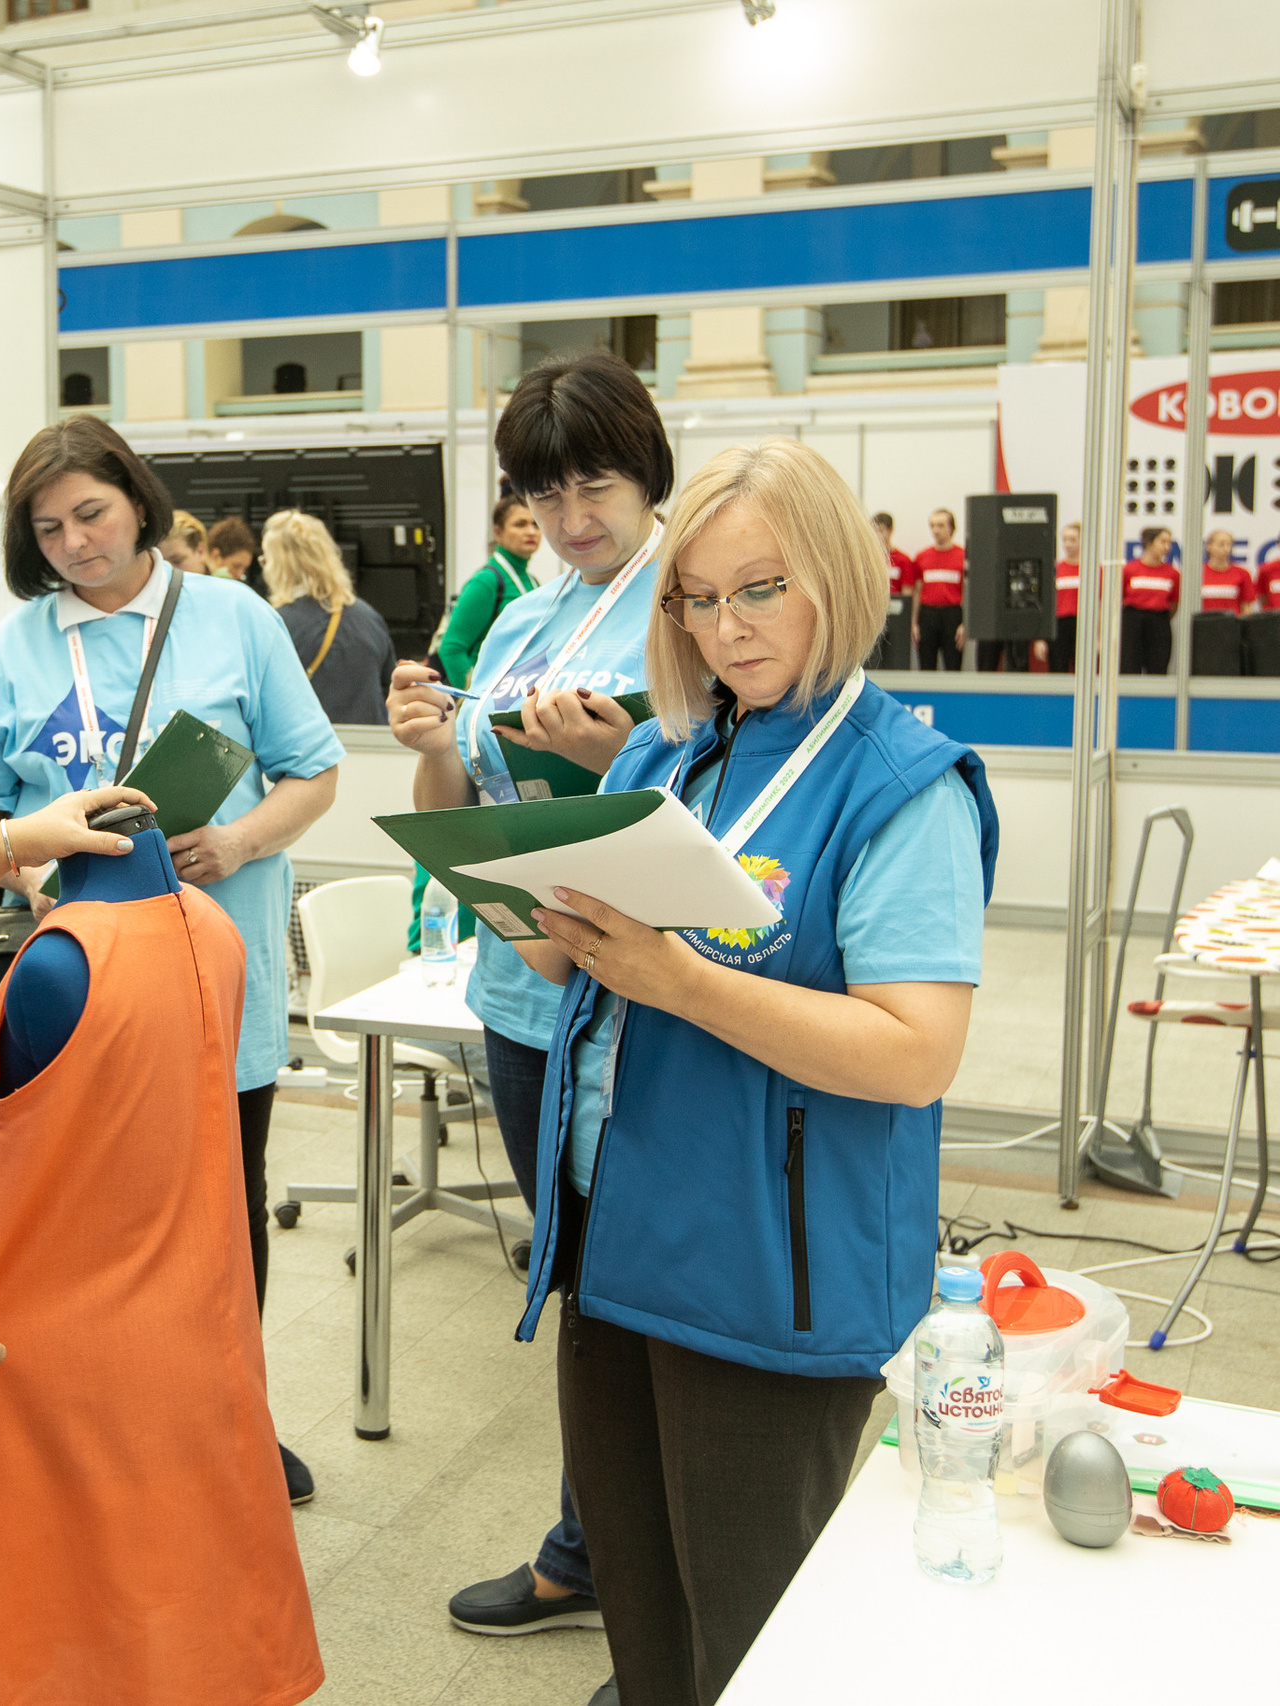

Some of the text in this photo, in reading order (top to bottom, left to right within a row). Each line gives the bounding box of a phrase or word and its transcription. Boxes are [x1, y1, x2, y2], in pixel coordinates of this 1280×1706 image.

[493, 669, 635, 700] ЭКПЕРТ
[743, 768, 796, 831] АБИЛИМПИКС 2022
[747, 932, 792, 964] ОБЛАСТЬ
